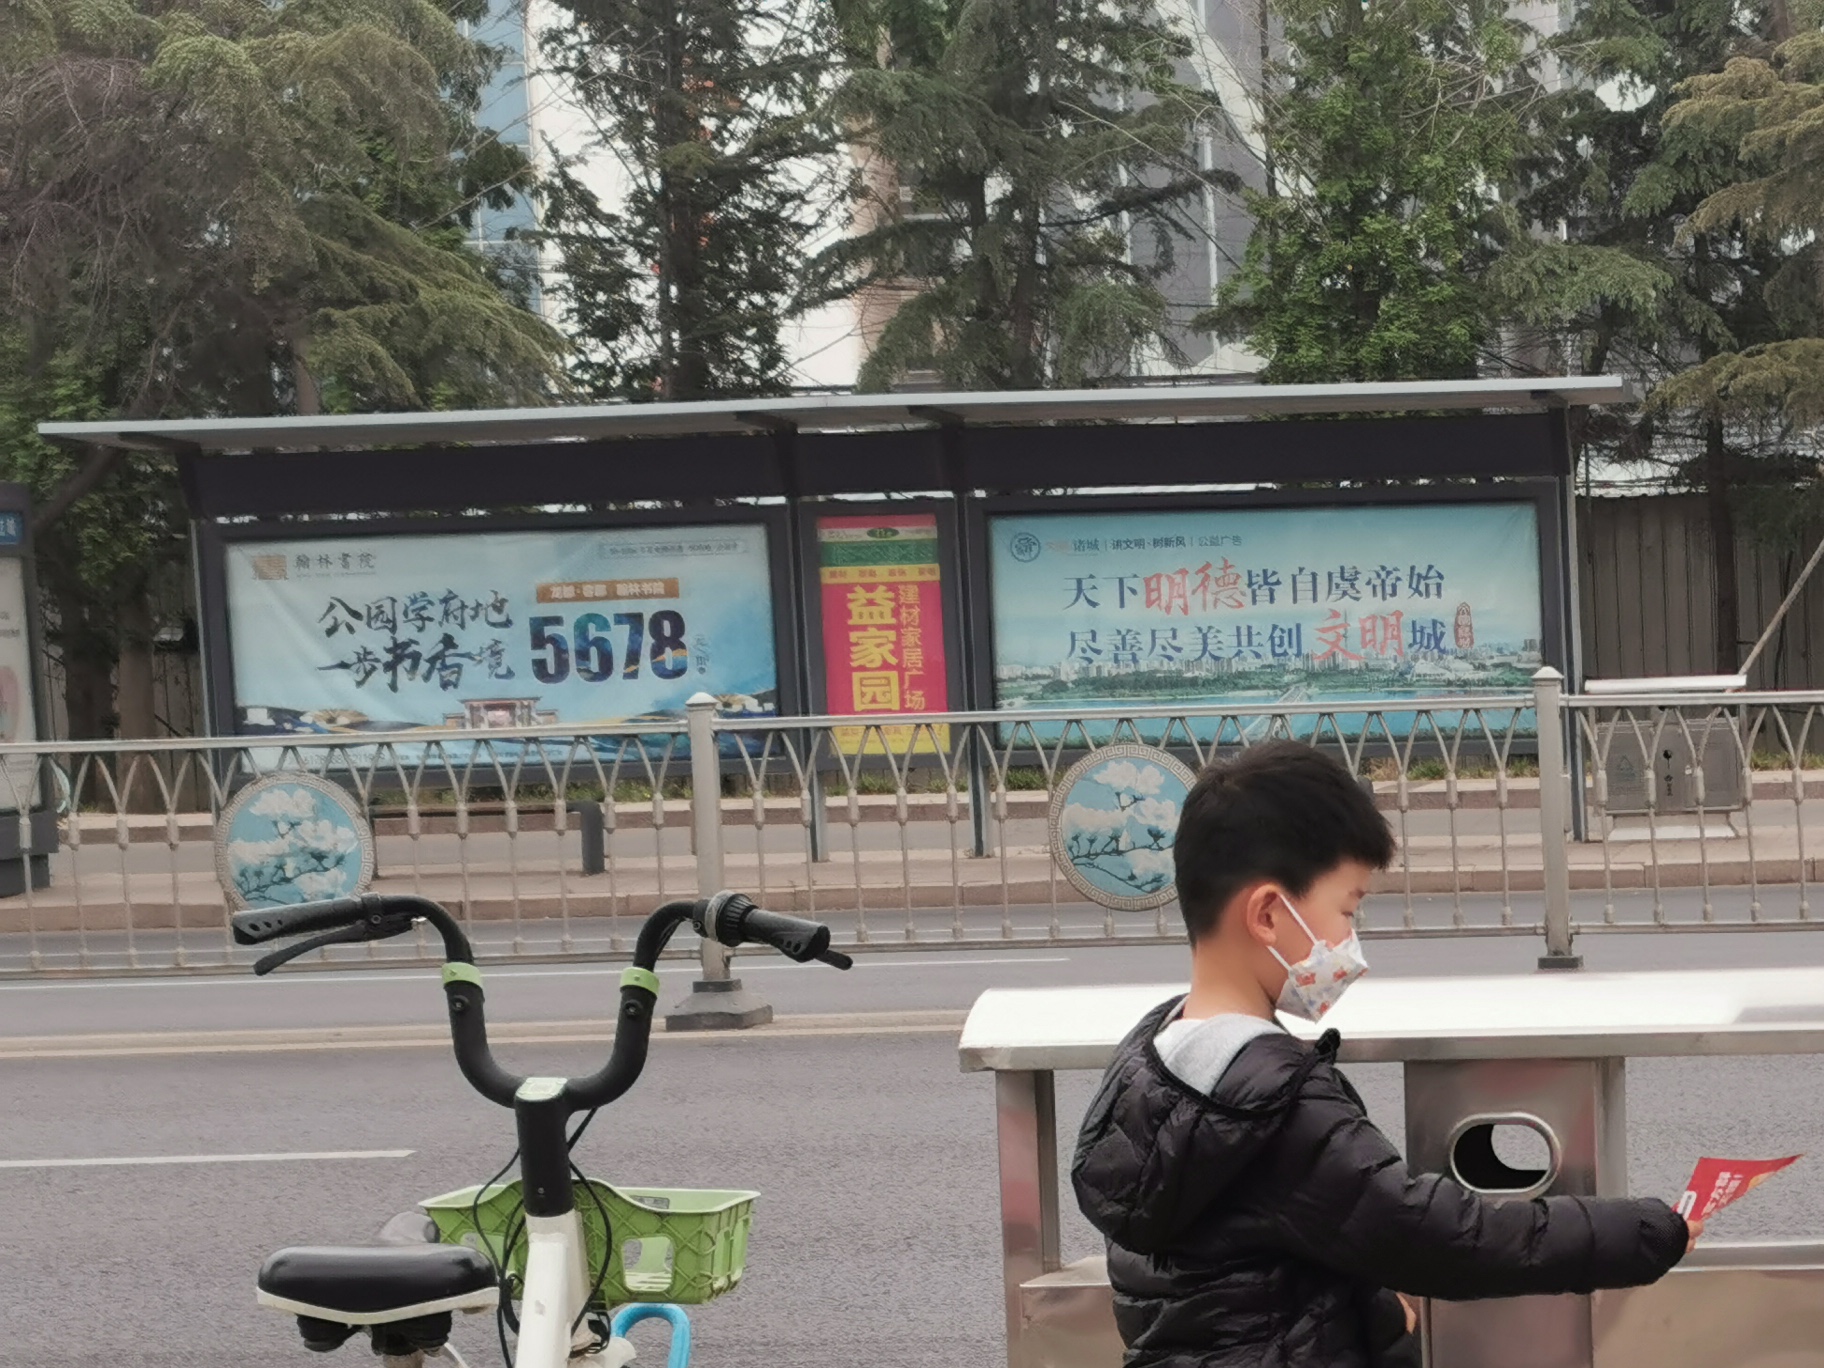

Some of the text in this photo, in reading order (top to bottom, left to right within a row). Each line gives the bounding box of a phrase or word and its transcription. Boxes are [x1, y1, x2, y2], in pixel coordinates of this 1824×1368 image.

[318, 589, 513, 638] 公园学府地
[1063, 556, 1446, 616] 天下明德皆自虞帝始
[316, 633, 517, 693] 一步书香境
[528, 609, 689, 684] 5678
[846, 584, 900, 713] 益家园
[898, 584, 926, 712] 建材家居广场
[1068, 608, 1448, 667] 尽善尽美共创文明城
